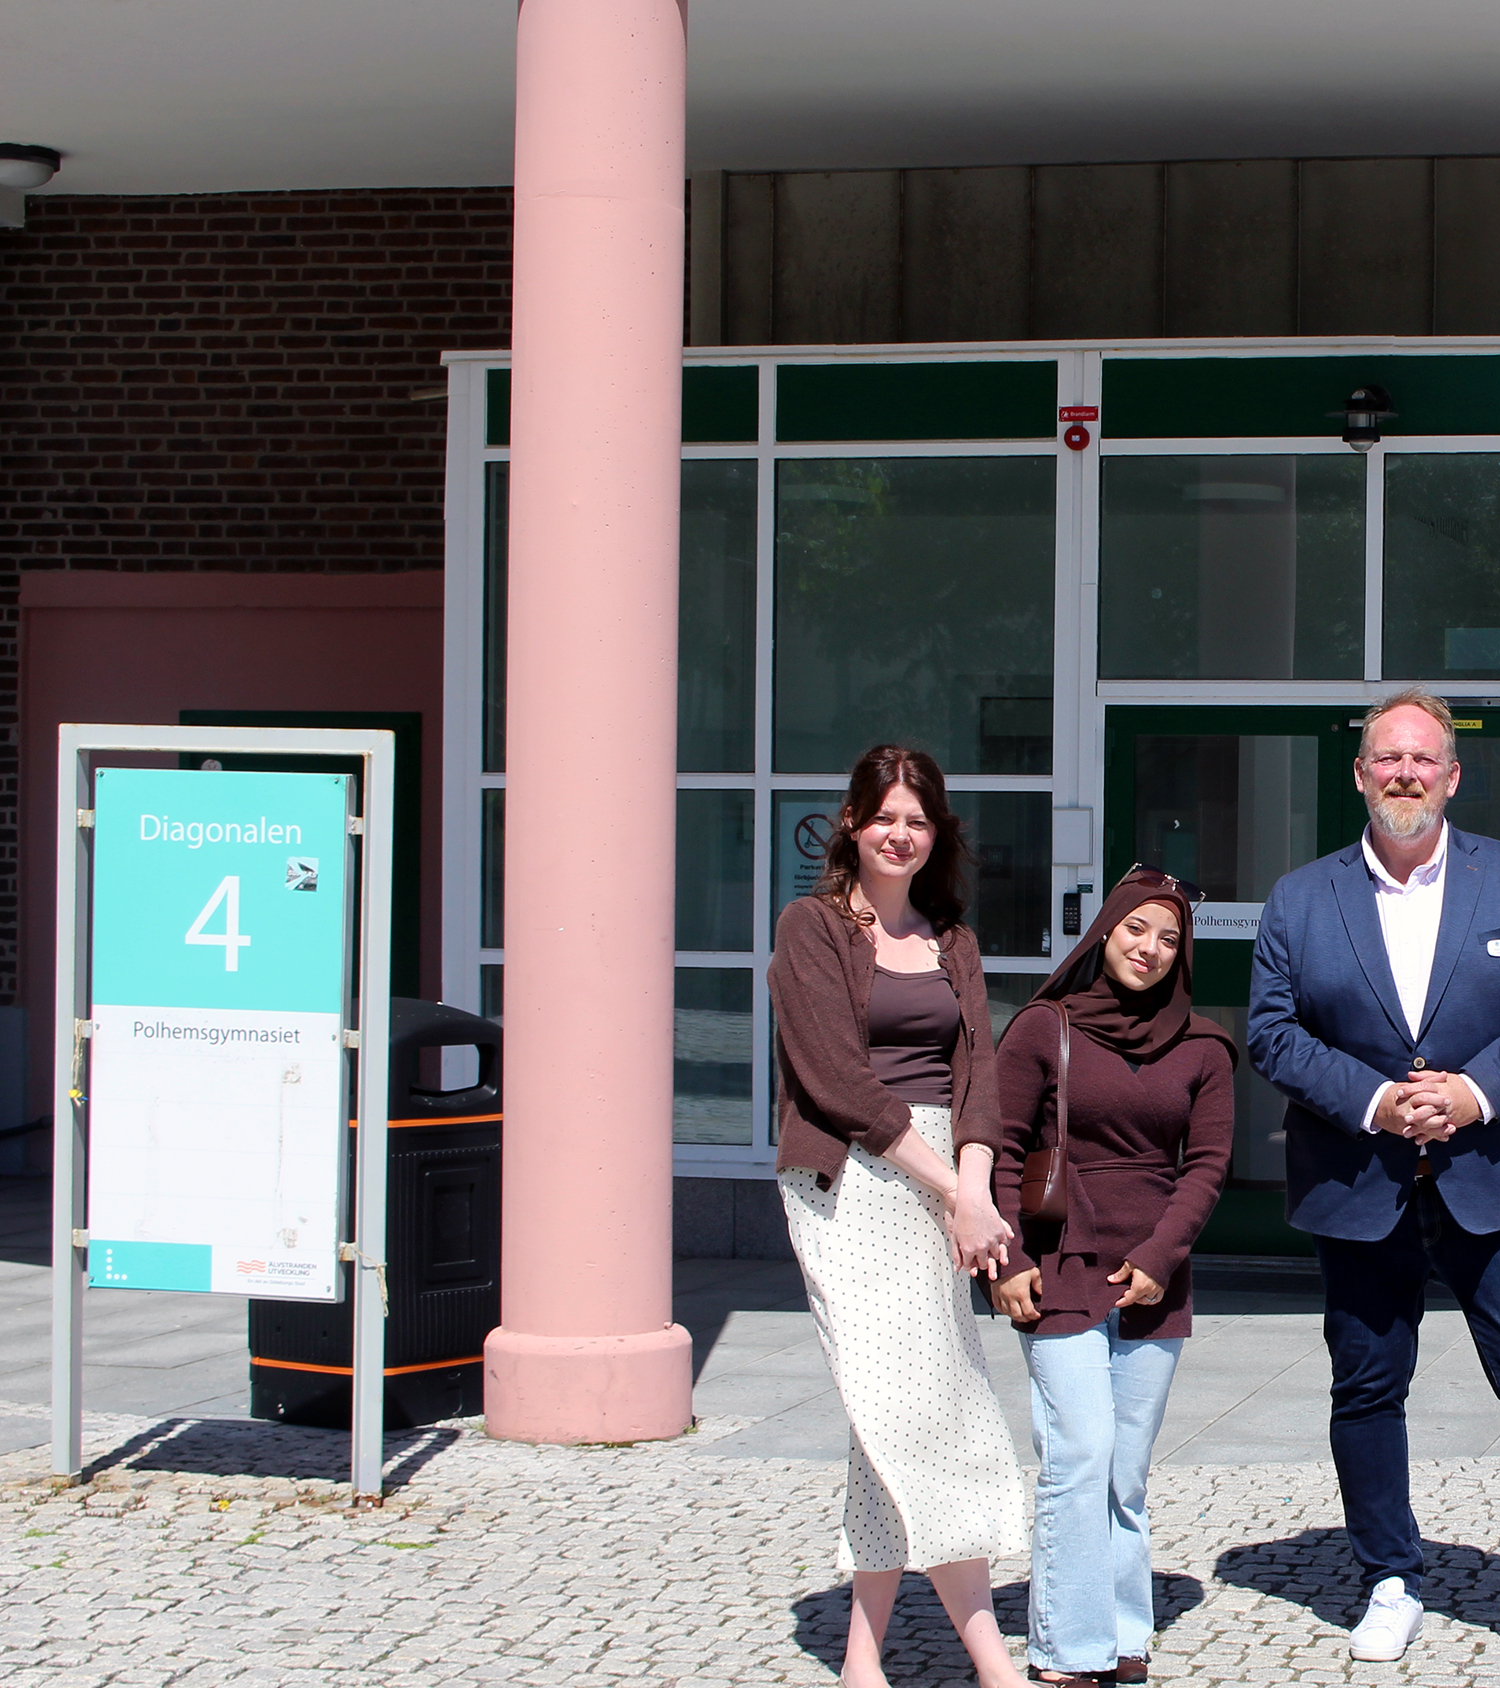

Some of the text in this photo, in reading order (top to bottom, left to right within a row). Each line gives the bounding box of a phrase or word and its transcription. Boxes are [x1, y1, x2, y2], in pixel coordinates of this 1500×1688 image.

[139, 814, 302, 849] Diagonalen
[185, 875, 251, 972] 4
[133, 1021, 301, 1045] Polhemsgymnasiet
[268, 1261, 317, 1270] ÄLVSTRANDEN
[268, 1268, 310, 1276] UTVECKLING
